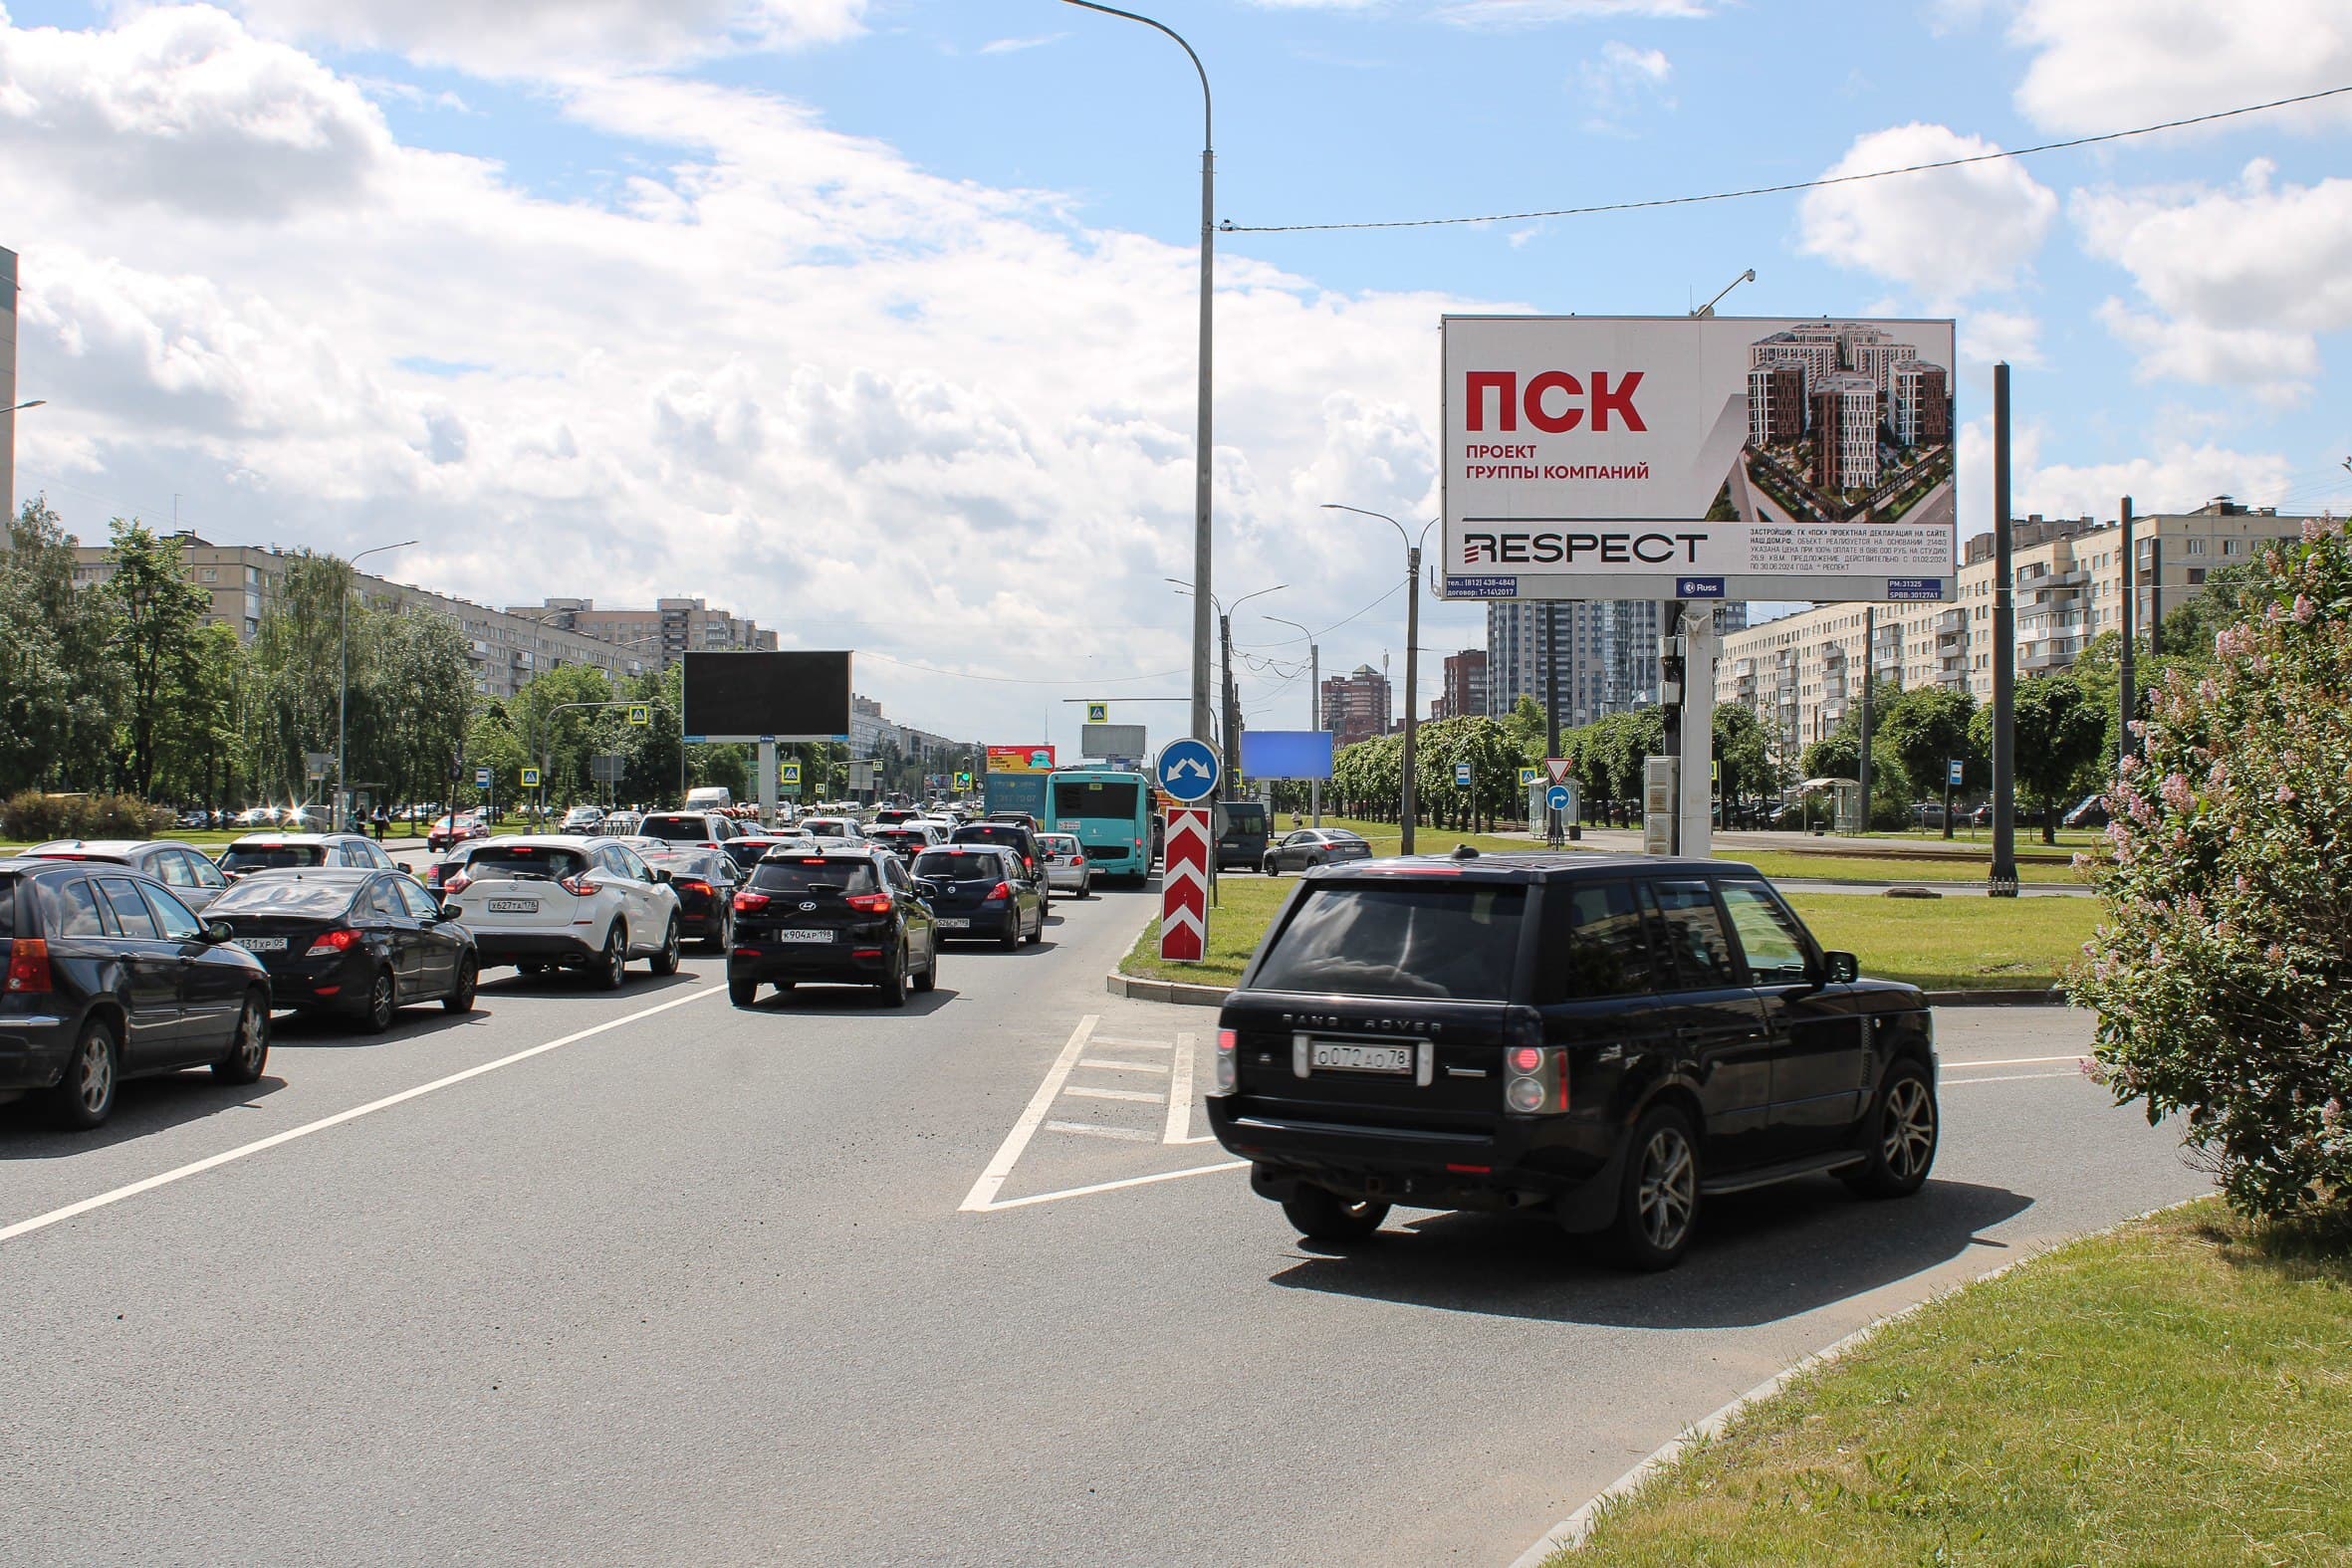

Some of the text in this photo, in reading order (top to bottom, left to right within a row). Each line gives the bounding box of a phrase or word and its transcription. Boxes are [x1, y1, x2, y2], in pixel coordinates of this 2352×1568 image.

[1466, 370, 1648, 433] ПСК
[1466, 445, 1536, 459] ПРОЕКТ
[1466, 461, 1649, 479] ГРУППЫ КОМПАНИЙ
[1830, 529, 1867, 538] ПРОЕКТНАЯ
[1869, 529, 1913, 538] ДЕКЛАРАЦИЯ
[1914, 529, 1924, 538] НА
[1926, 529, 1947, 538] САЙТЕ
[1464, 533, 1708, 563] RESPECT
[1797, 537, 1822, 546] ОБЪЕКТ
[1826, 537, 1871, 546] РЕАЛИЗУЕТСЯ
[1873, 537, 1883, 546] НА
[1887, 537, 1923, 546] ОСНОВАНИИ
[1844, 555, 1899, 563] ДЕЙСТВИТЕЛЬНО
[1364, 1019, 1442, 1032] ROVER
